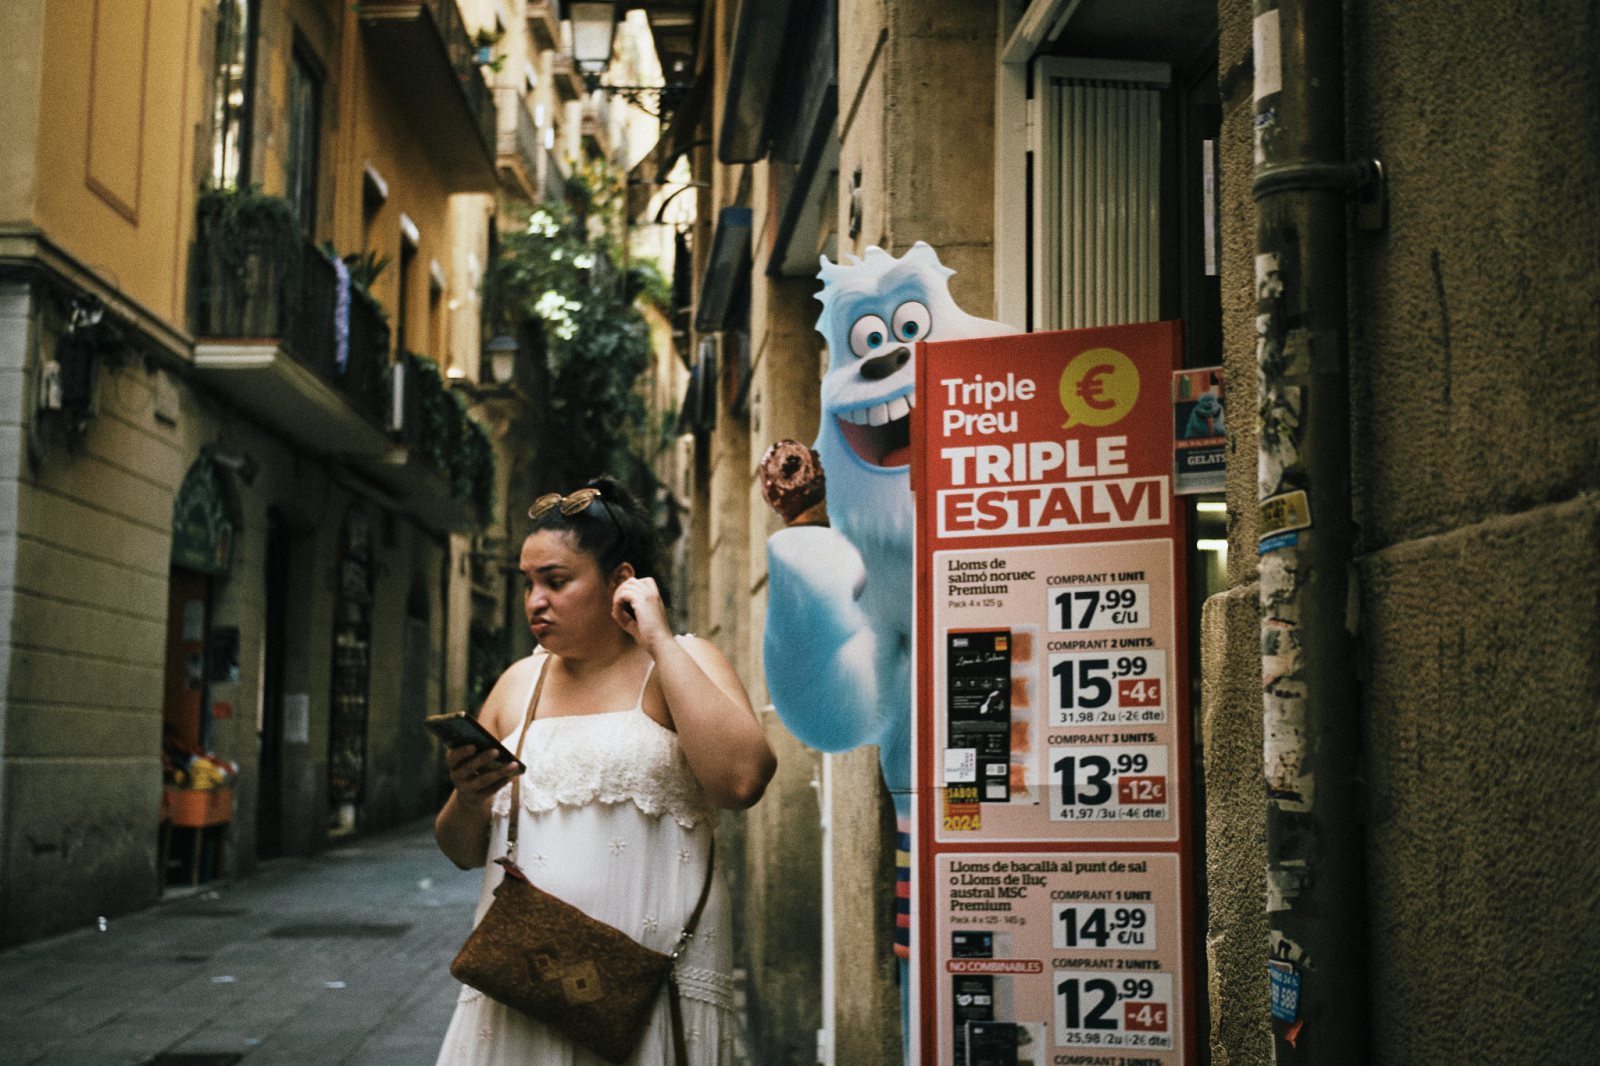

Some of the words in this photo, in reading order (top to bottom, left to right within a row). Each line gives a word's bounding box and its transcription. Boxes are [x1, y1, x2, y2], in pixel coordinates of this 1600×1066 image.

[941, 372, 1036, 410] Triple
[943, 410, 1018, 437] Preu
[941, 435, 1129, 486] TRIPLE
[944, 480, 1162, 532] ESTALVI
[948, 559, 987, 571] Lloms
[990, 558, 1006, 569] de
[948, 571, 987, 584] salmó
[989, 570, 1036, 582] noruec
[1046, 573, 1108, 585] COMPRANT
[1110, 572, 1115, 582] 1
[948, 583, 1009, 596] Premium
[948, 599, 967, 609] Pack
[982, 598, 995, 607] 125
[1111, 610, 1139, 624] €/u
[1047, 639, 1108, 651] COMPRANT
[1111, 639, 1117, 649] 2
[1060, 712, 1094, 723] 31,98
[1048, 734, 1110, 745] COMPRANT
[1112, 733, 1119, 743] 3
[1060, 808, 1094, 820] 41,97
[943, 814, 982, 831] 2024
[950, 861, 990, 872] Lloms
[992, 861, 1009, 872] de
[1010, 861, 1058, 872] bacallà
[1061, 861, 1073, 872] al
[1075, 862, 1106, 875] punt
[1109, 861, 1125, 872] de
[1128, 861, 1147, 873] sal
[950, 876, 959, 885] o
[961, 874, 1001, 885] Lloms
[1003, 874, 1019, 885] de
[1022, 874, 1047, 888] lluç
[950, 887, 995, 898] austral
[997, 886, 1027, 898] MSC
[1050, 890, 1112, 900] COMPRANT
[1116, 891, 1121, 899] 1
[950, 899, 1011, 911] Premium
[1117, 931, 1145, 945] €/u
[950, 961, 965, 971] NO
[967, 961, 1041, 972] COMBINABLES
[1052, 958, 1113, 968] COMPRANT
[1117, 959, 1123, 968] 2
[1066, 1032, 1100, 1044] 25,98
